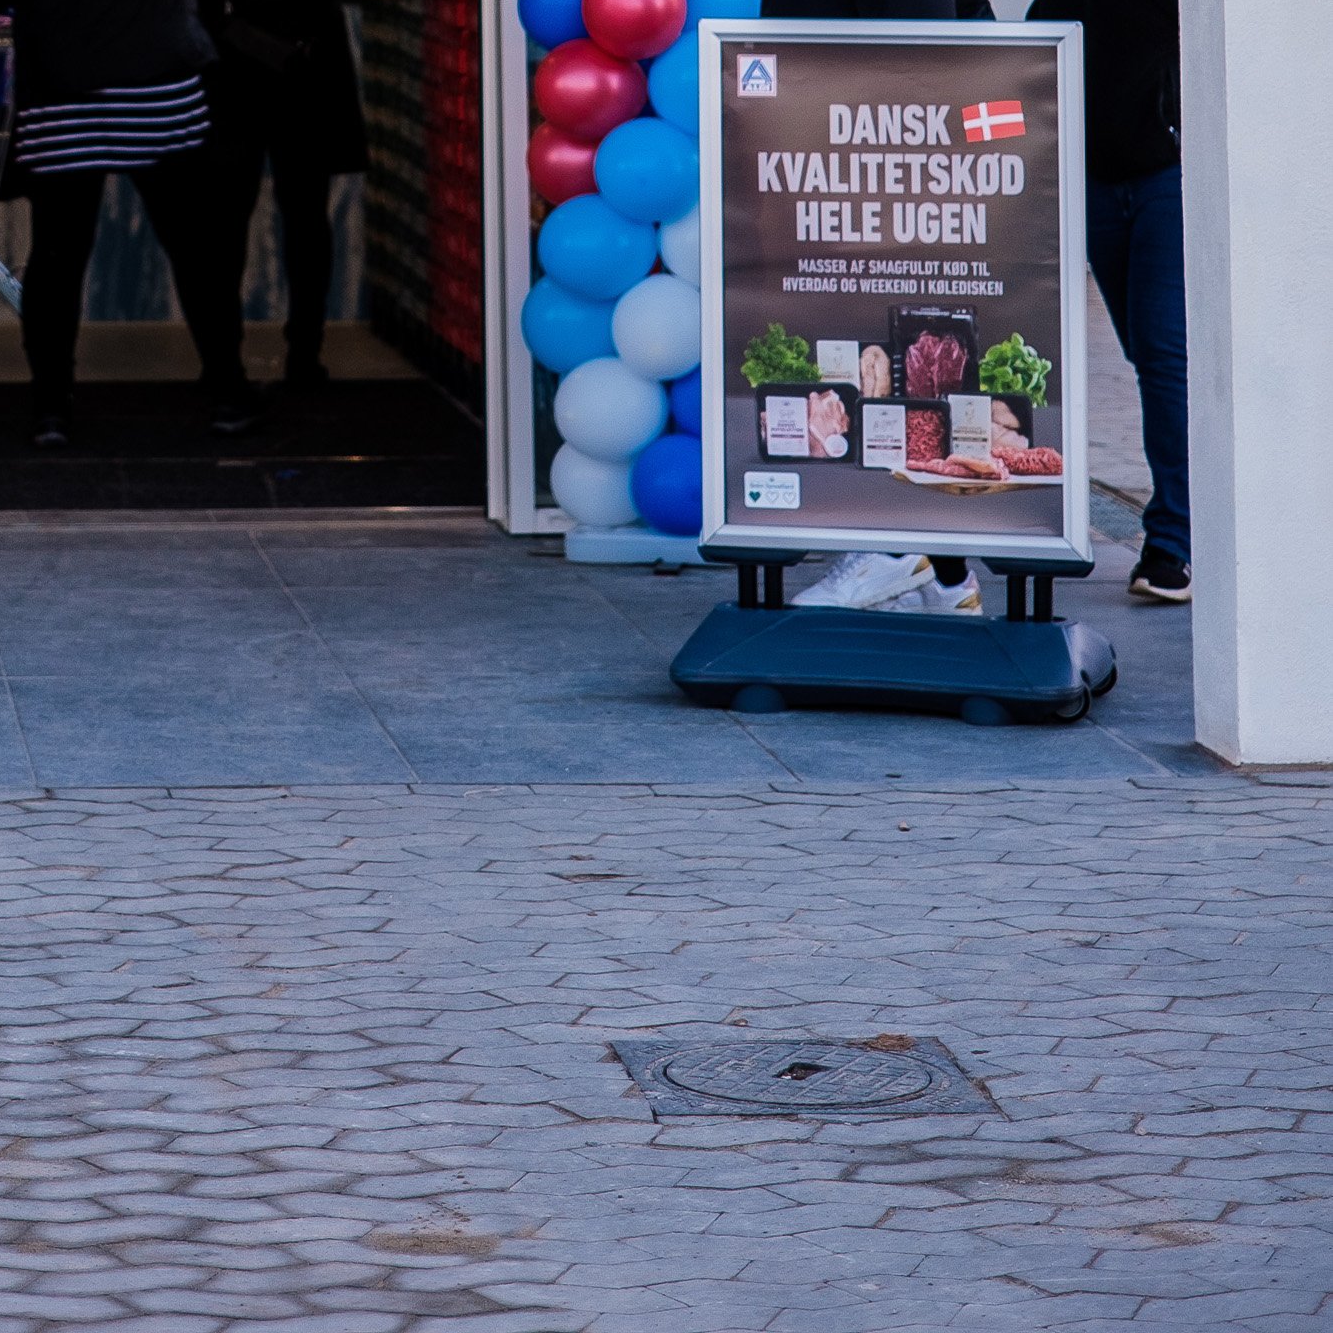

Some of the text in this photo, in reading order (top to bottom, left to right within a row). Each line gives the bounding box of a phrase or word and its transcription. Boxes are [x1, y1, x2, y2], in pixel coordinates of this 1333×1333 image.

[829, 104, 951, 146] DANSK
[758, 151, 1025, 196] KVALITETSKØD
[796, 201, 986, 244] HELE UGEN
[782, 277, 837, 292] HVERDAG
[840, 278, 857, 293] OG
[860, 279, 917, 294] WEEKEND
[928, 281, 1004, 296] KØLEDISKEN
[798, 259, 990, 277] MASSER AF SMAGFULDT KØD TIL
